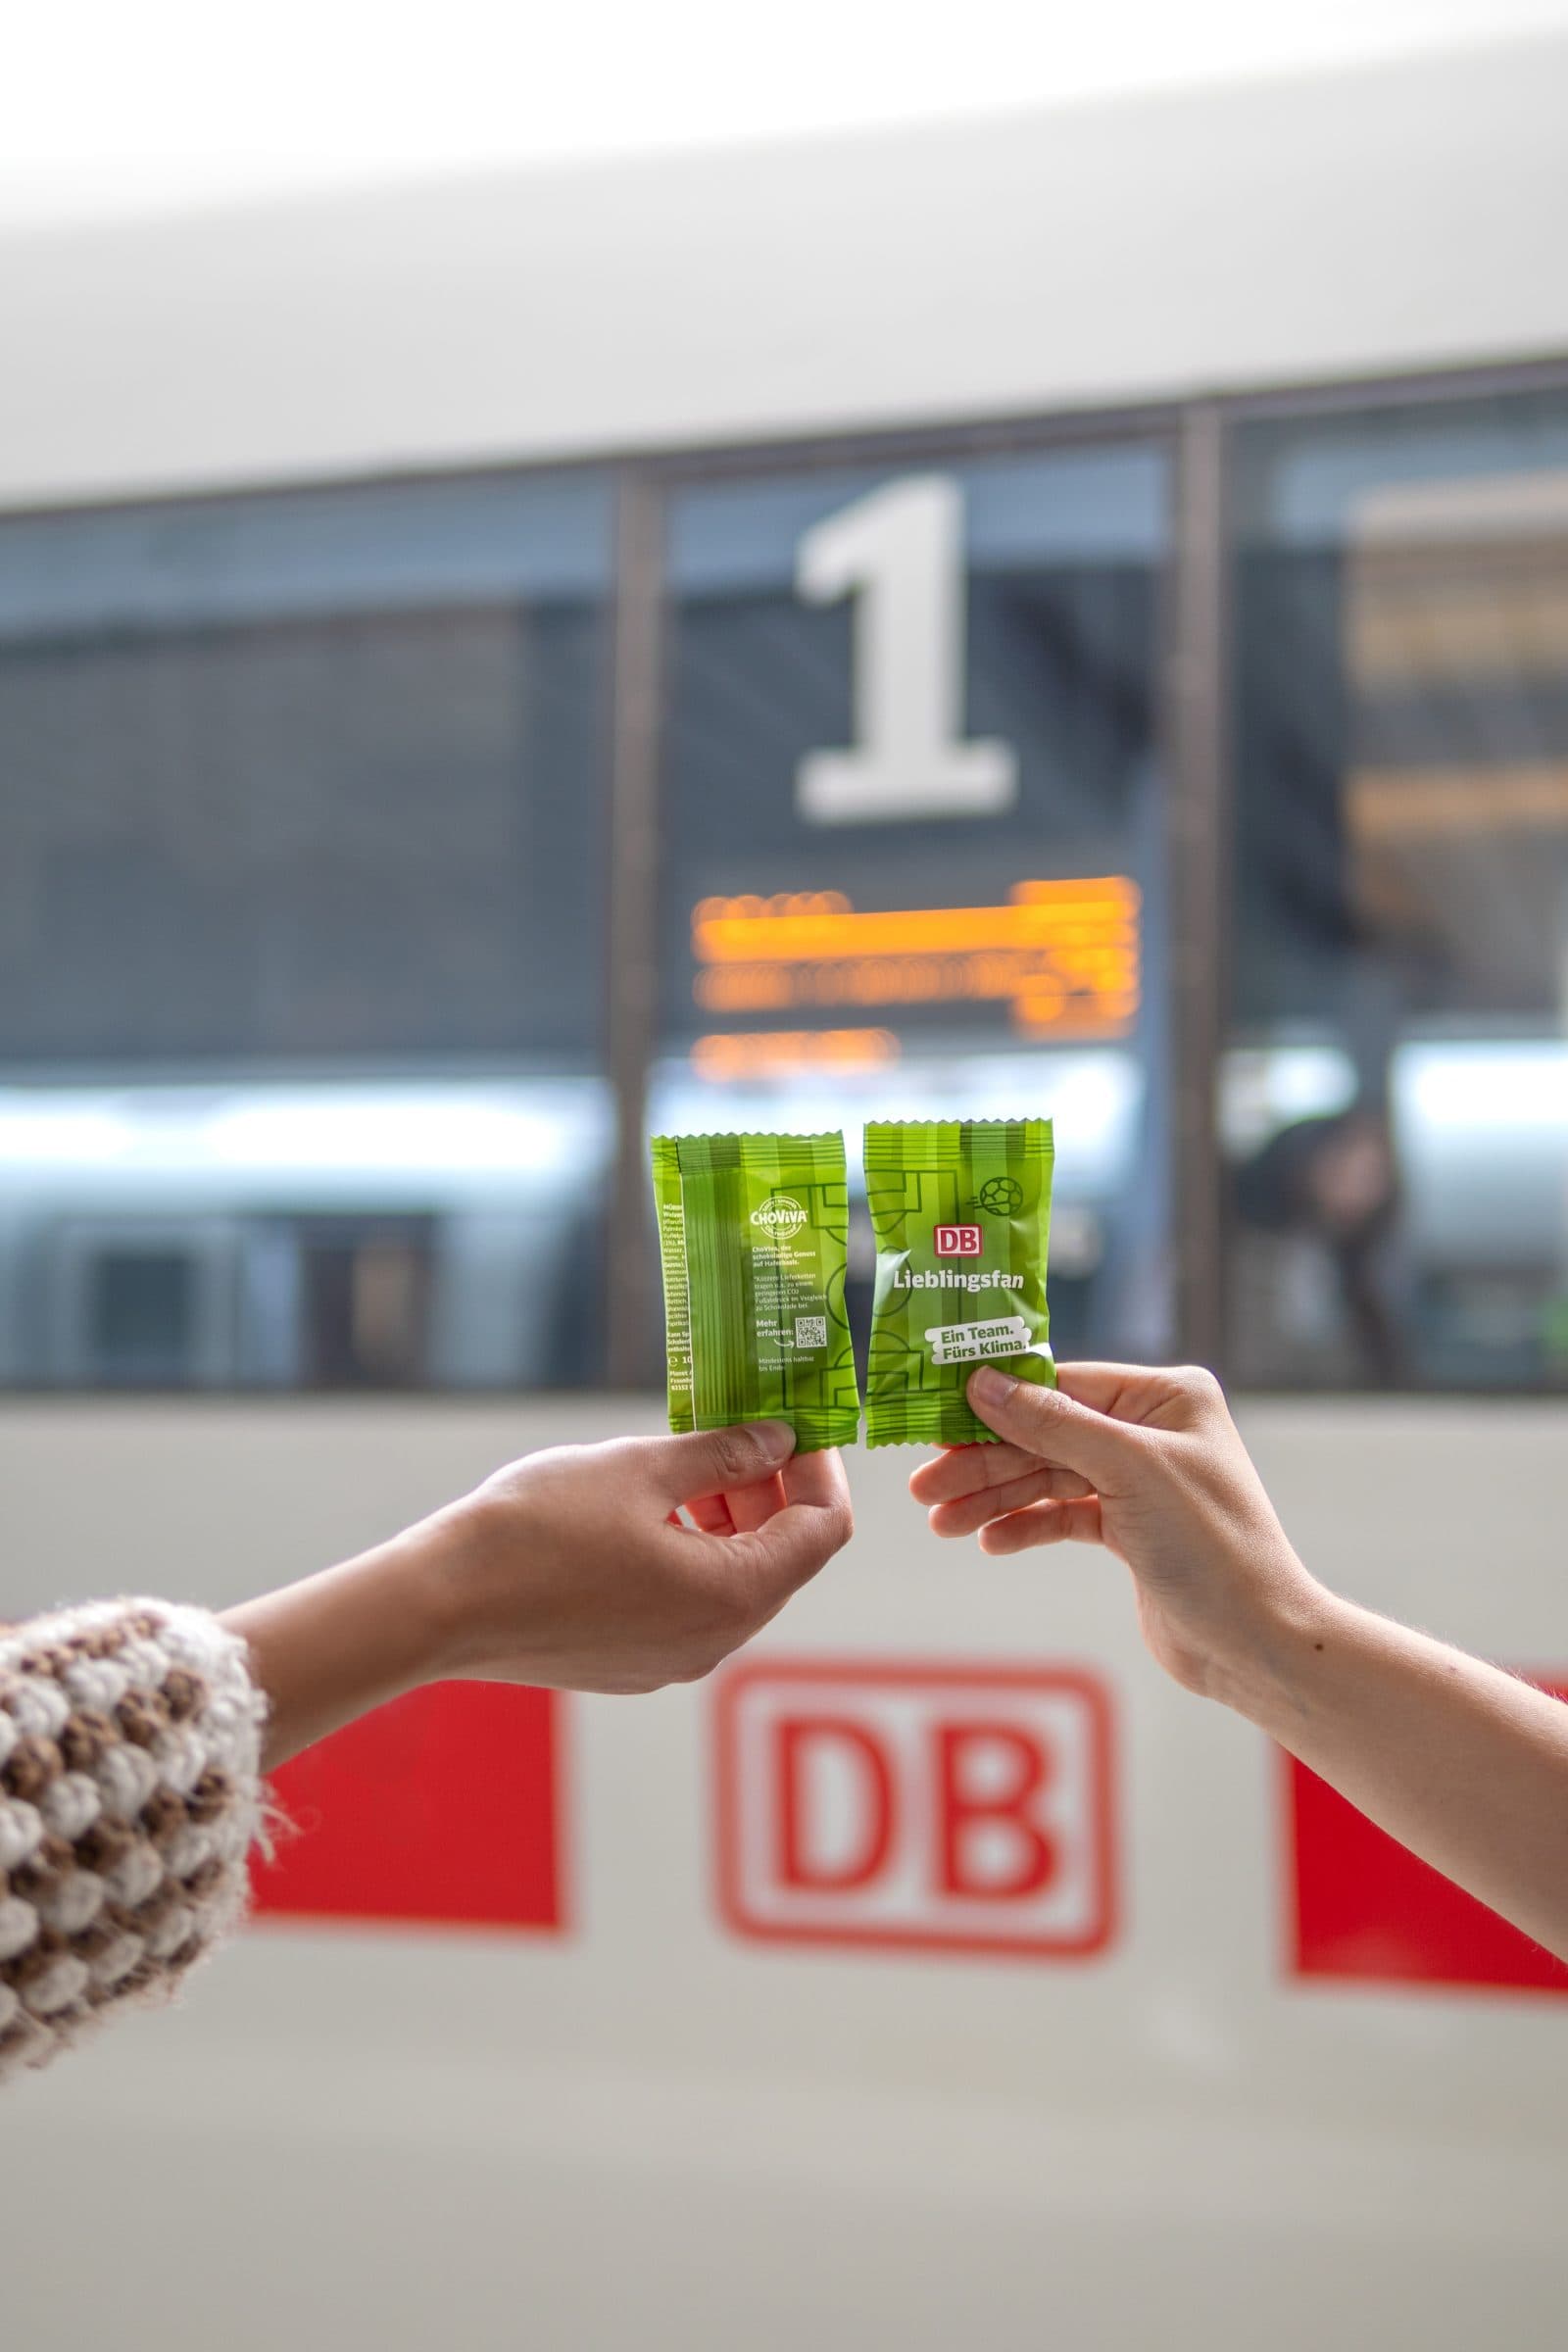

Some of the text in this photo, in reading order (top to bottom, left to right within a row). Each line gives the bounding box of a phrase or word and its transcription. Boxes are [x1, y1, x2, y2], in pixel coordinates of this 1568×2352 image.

[940, 1229, 977, 1252] DB
[893, 1269, 1024, 1293] Lieblingsfan
[756, 1319, 777, 1328] Mehr
[757, 1328, 794, 1338] erfahren:
[941, 1324, 1014, 1345] Ein Team.
[943, 1340, 1026, 1360] Fürs Klima.
[772, 1714, 1062, 1904] DB
